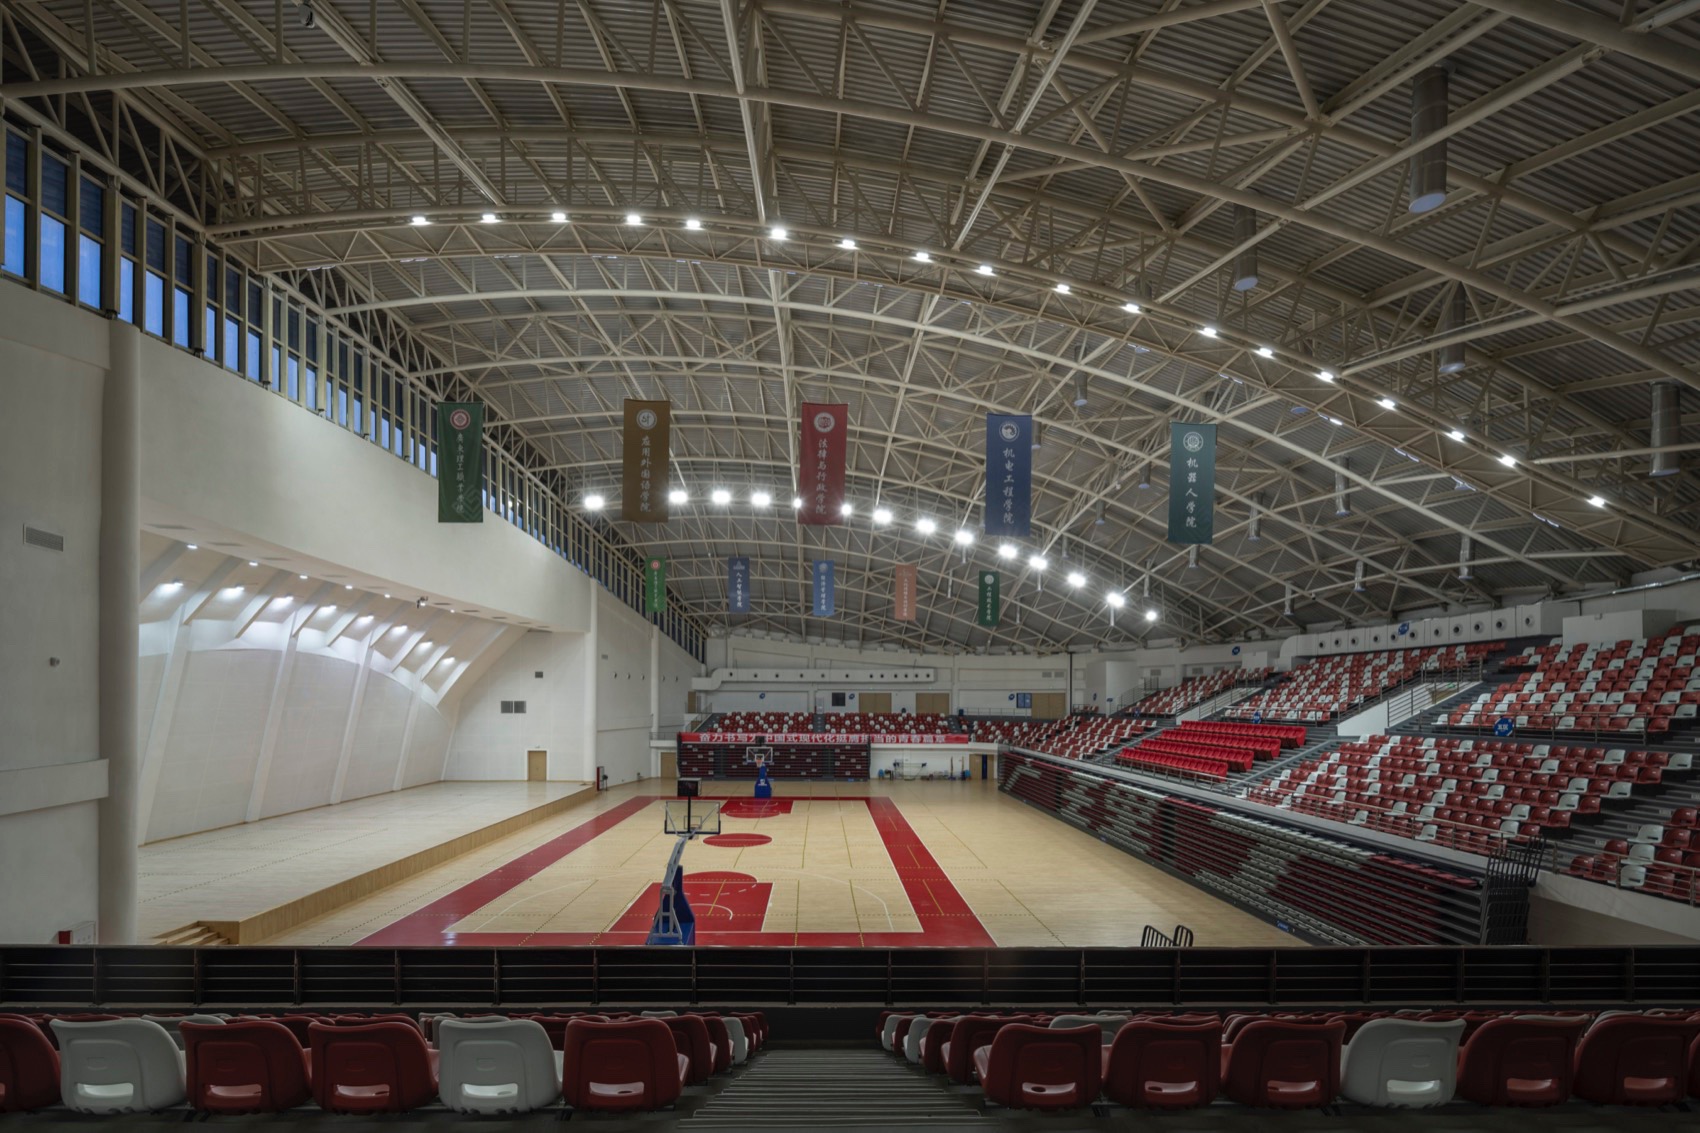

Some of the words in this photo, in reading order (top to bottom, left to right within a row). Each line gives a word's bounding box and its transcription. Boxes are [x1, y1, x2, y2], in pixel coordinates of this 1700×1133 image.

[815, 437, 828, 515] 法律与行政学院
[1002, 447, 1015, 525] 机电工程学院
[1185, 457, 1199, 529] 机器人学院
